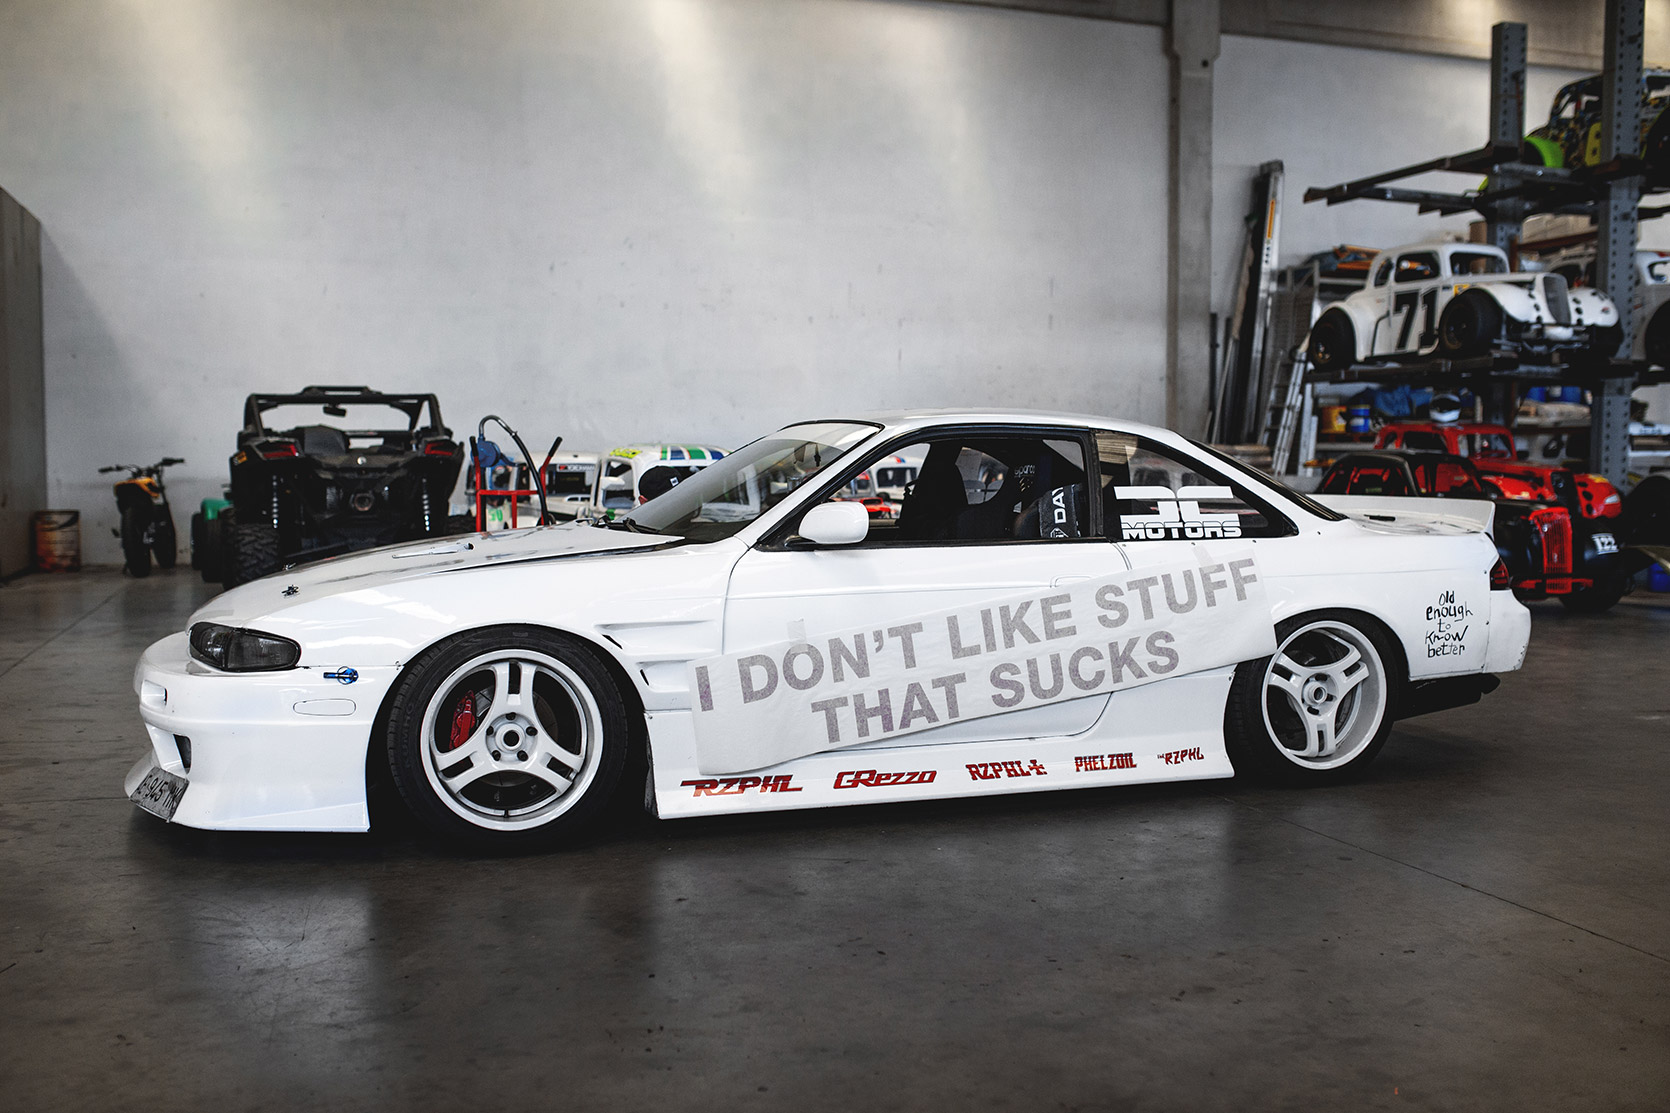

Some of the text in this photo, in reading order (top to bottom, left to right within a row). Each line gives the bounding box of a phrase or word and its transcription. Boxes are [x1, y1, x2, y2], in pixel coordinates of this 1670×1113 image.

[1393, 289, 1439, 352] 71
[1120, 521, 1242, 540] MOTORS
[1426, 601, 1473, 622] enough
[1437, 618, 1452, 632] to
[695, 559, 1257, 712] I DON'T LIKE STUFF
[1427, 642, 1465, 658] better
[811, 631, 1179, 744] THAT SUCKS
[1164, 746, 1205, 765] RZPHL
